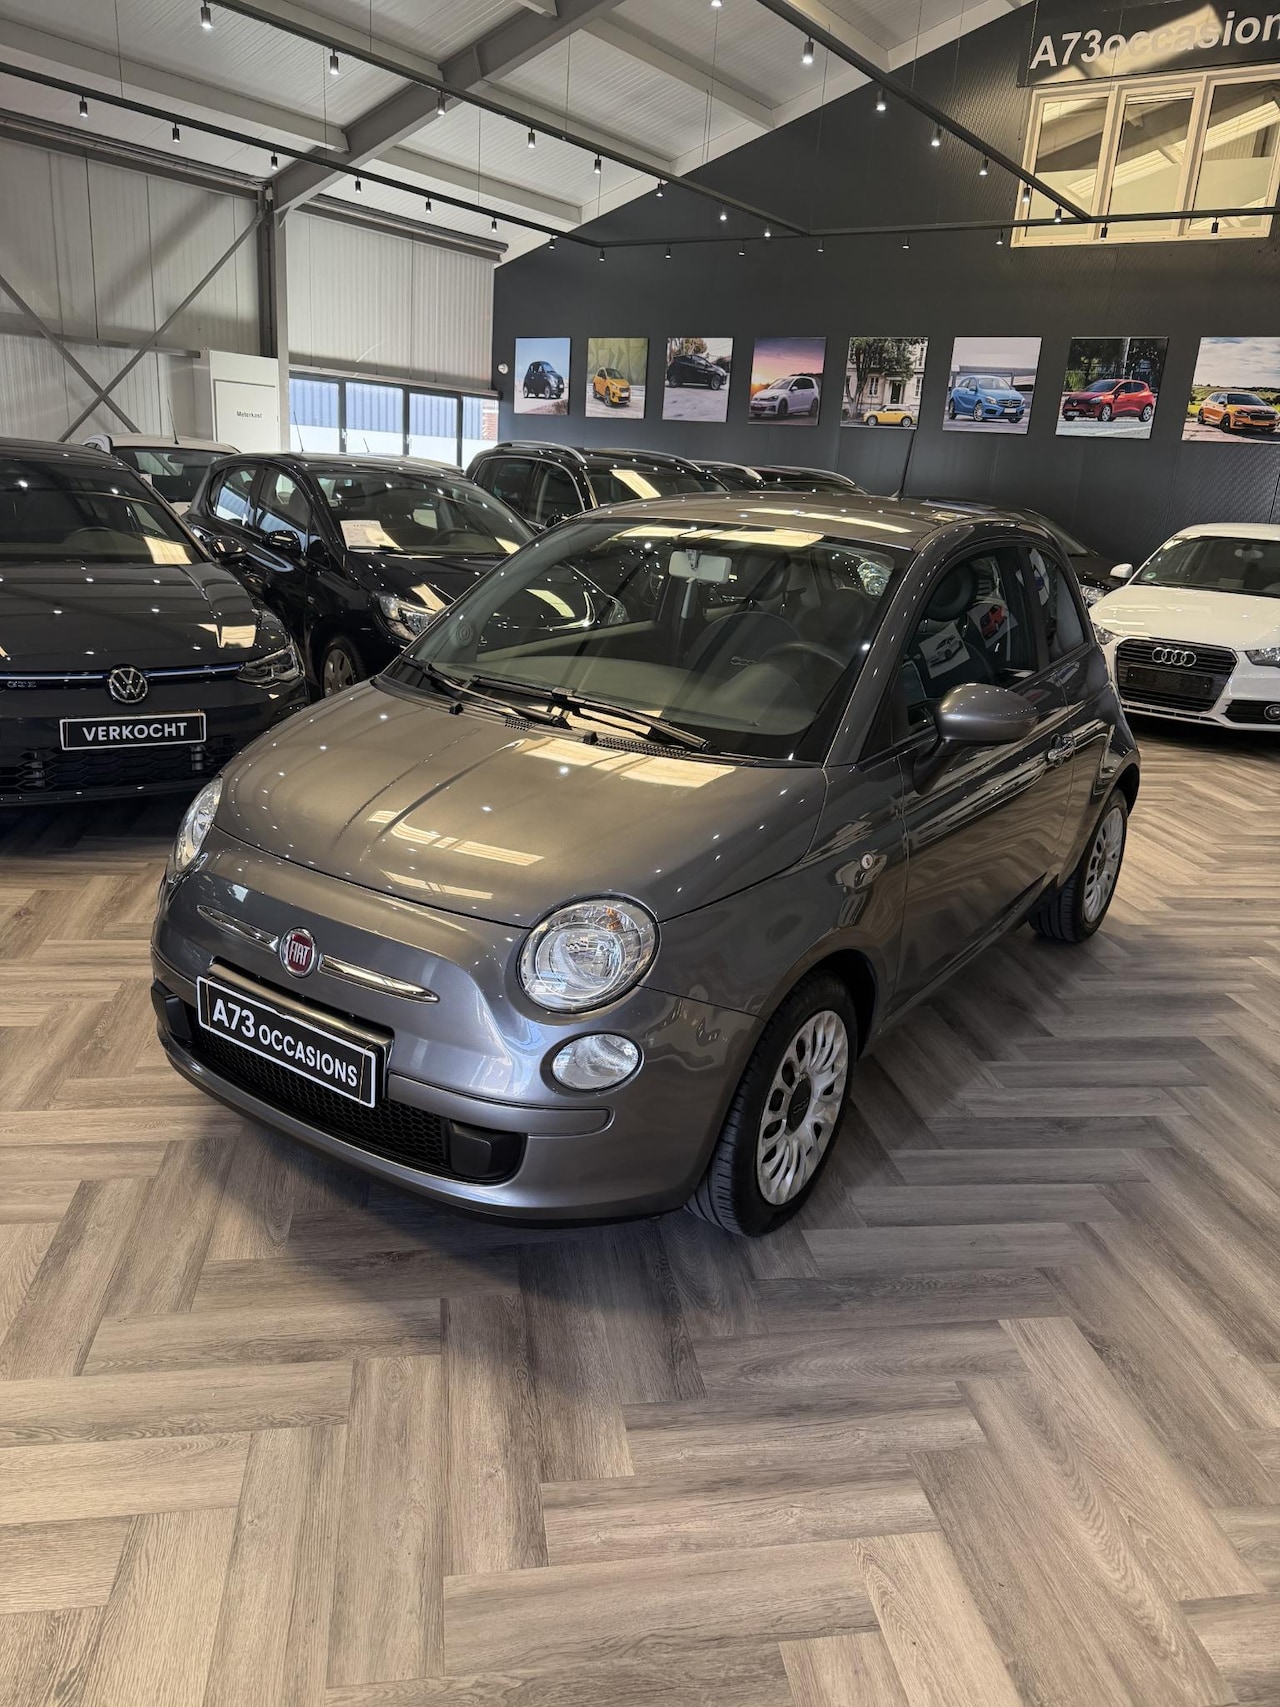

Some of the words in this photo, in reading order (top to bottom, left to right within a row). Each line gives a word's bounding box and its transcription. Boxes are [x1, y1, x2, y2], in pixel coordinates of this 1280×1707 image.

[82, 722, 188, 742] VERKOCHT
[289, 941, 310, 966] FIAT
[212, 998, 256, 1038] A73
[258, 1024, 358, 1087] OCCASIONS
